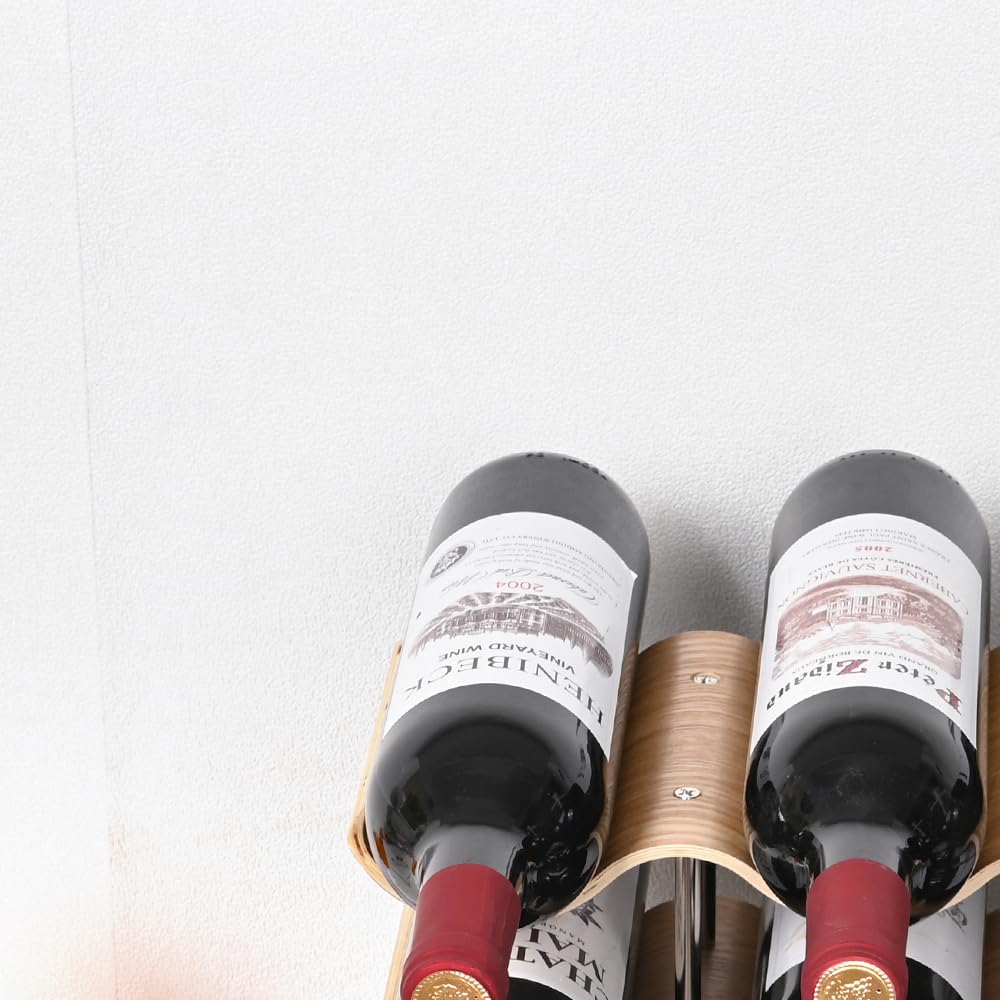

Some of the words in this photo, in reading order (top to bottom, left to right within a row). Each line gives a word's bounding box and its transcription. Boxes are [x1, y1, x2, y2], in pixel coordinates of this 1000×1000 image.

[495, 581, 544, 593] 2004
[777, 563, 876, 609] SAUVIGNON
[884, 564, 969, 615] CABERNET
[437, 644, 482, 662] WINE
[488, 643, 576, 676] VINEYARD
[874, 650, 896, 658] VIN
[898, 655, 938, 676] GRAND
[398, 655, 604, 726] HENIBECK
[877, 661, 962, 716] Peter
